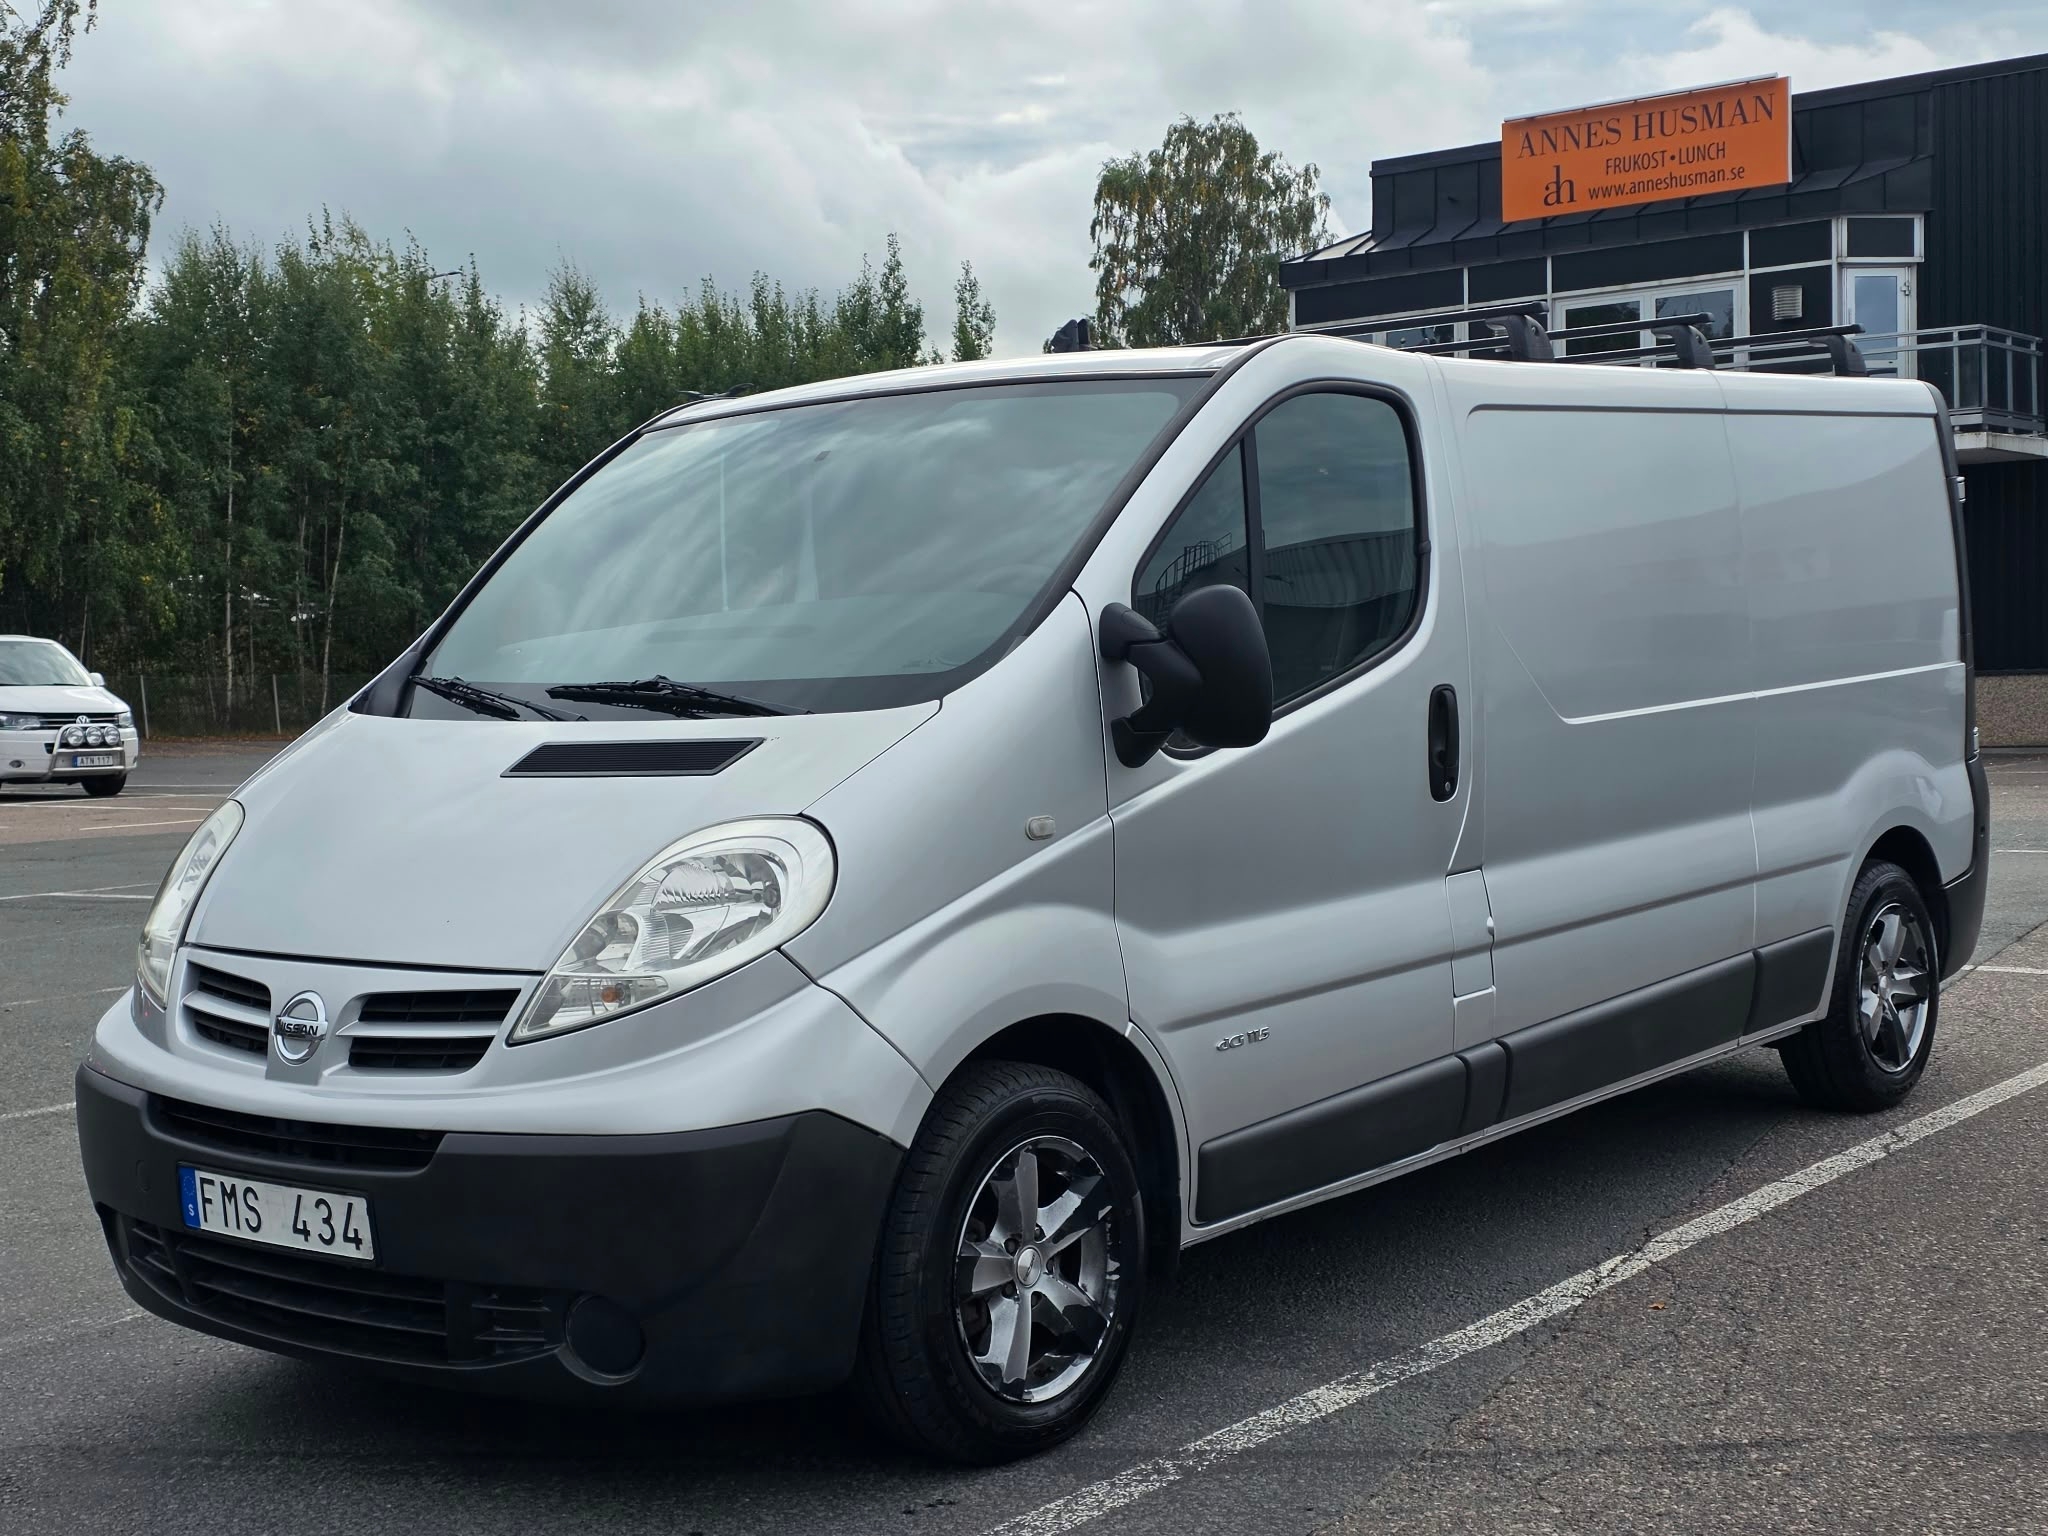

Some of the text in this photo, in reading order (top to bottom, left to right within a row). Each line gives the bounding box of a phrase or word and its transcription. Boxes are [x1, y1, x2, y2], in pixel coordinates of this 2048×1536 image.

[1517, 92, 1776, 158] ANNES HUSMAN
[1588, 165, 1745, 200] www.anneshusman.se
[276, 1019, 319, 1036] NISSAN
[200, 1176, 363, 1251] FMS 434
